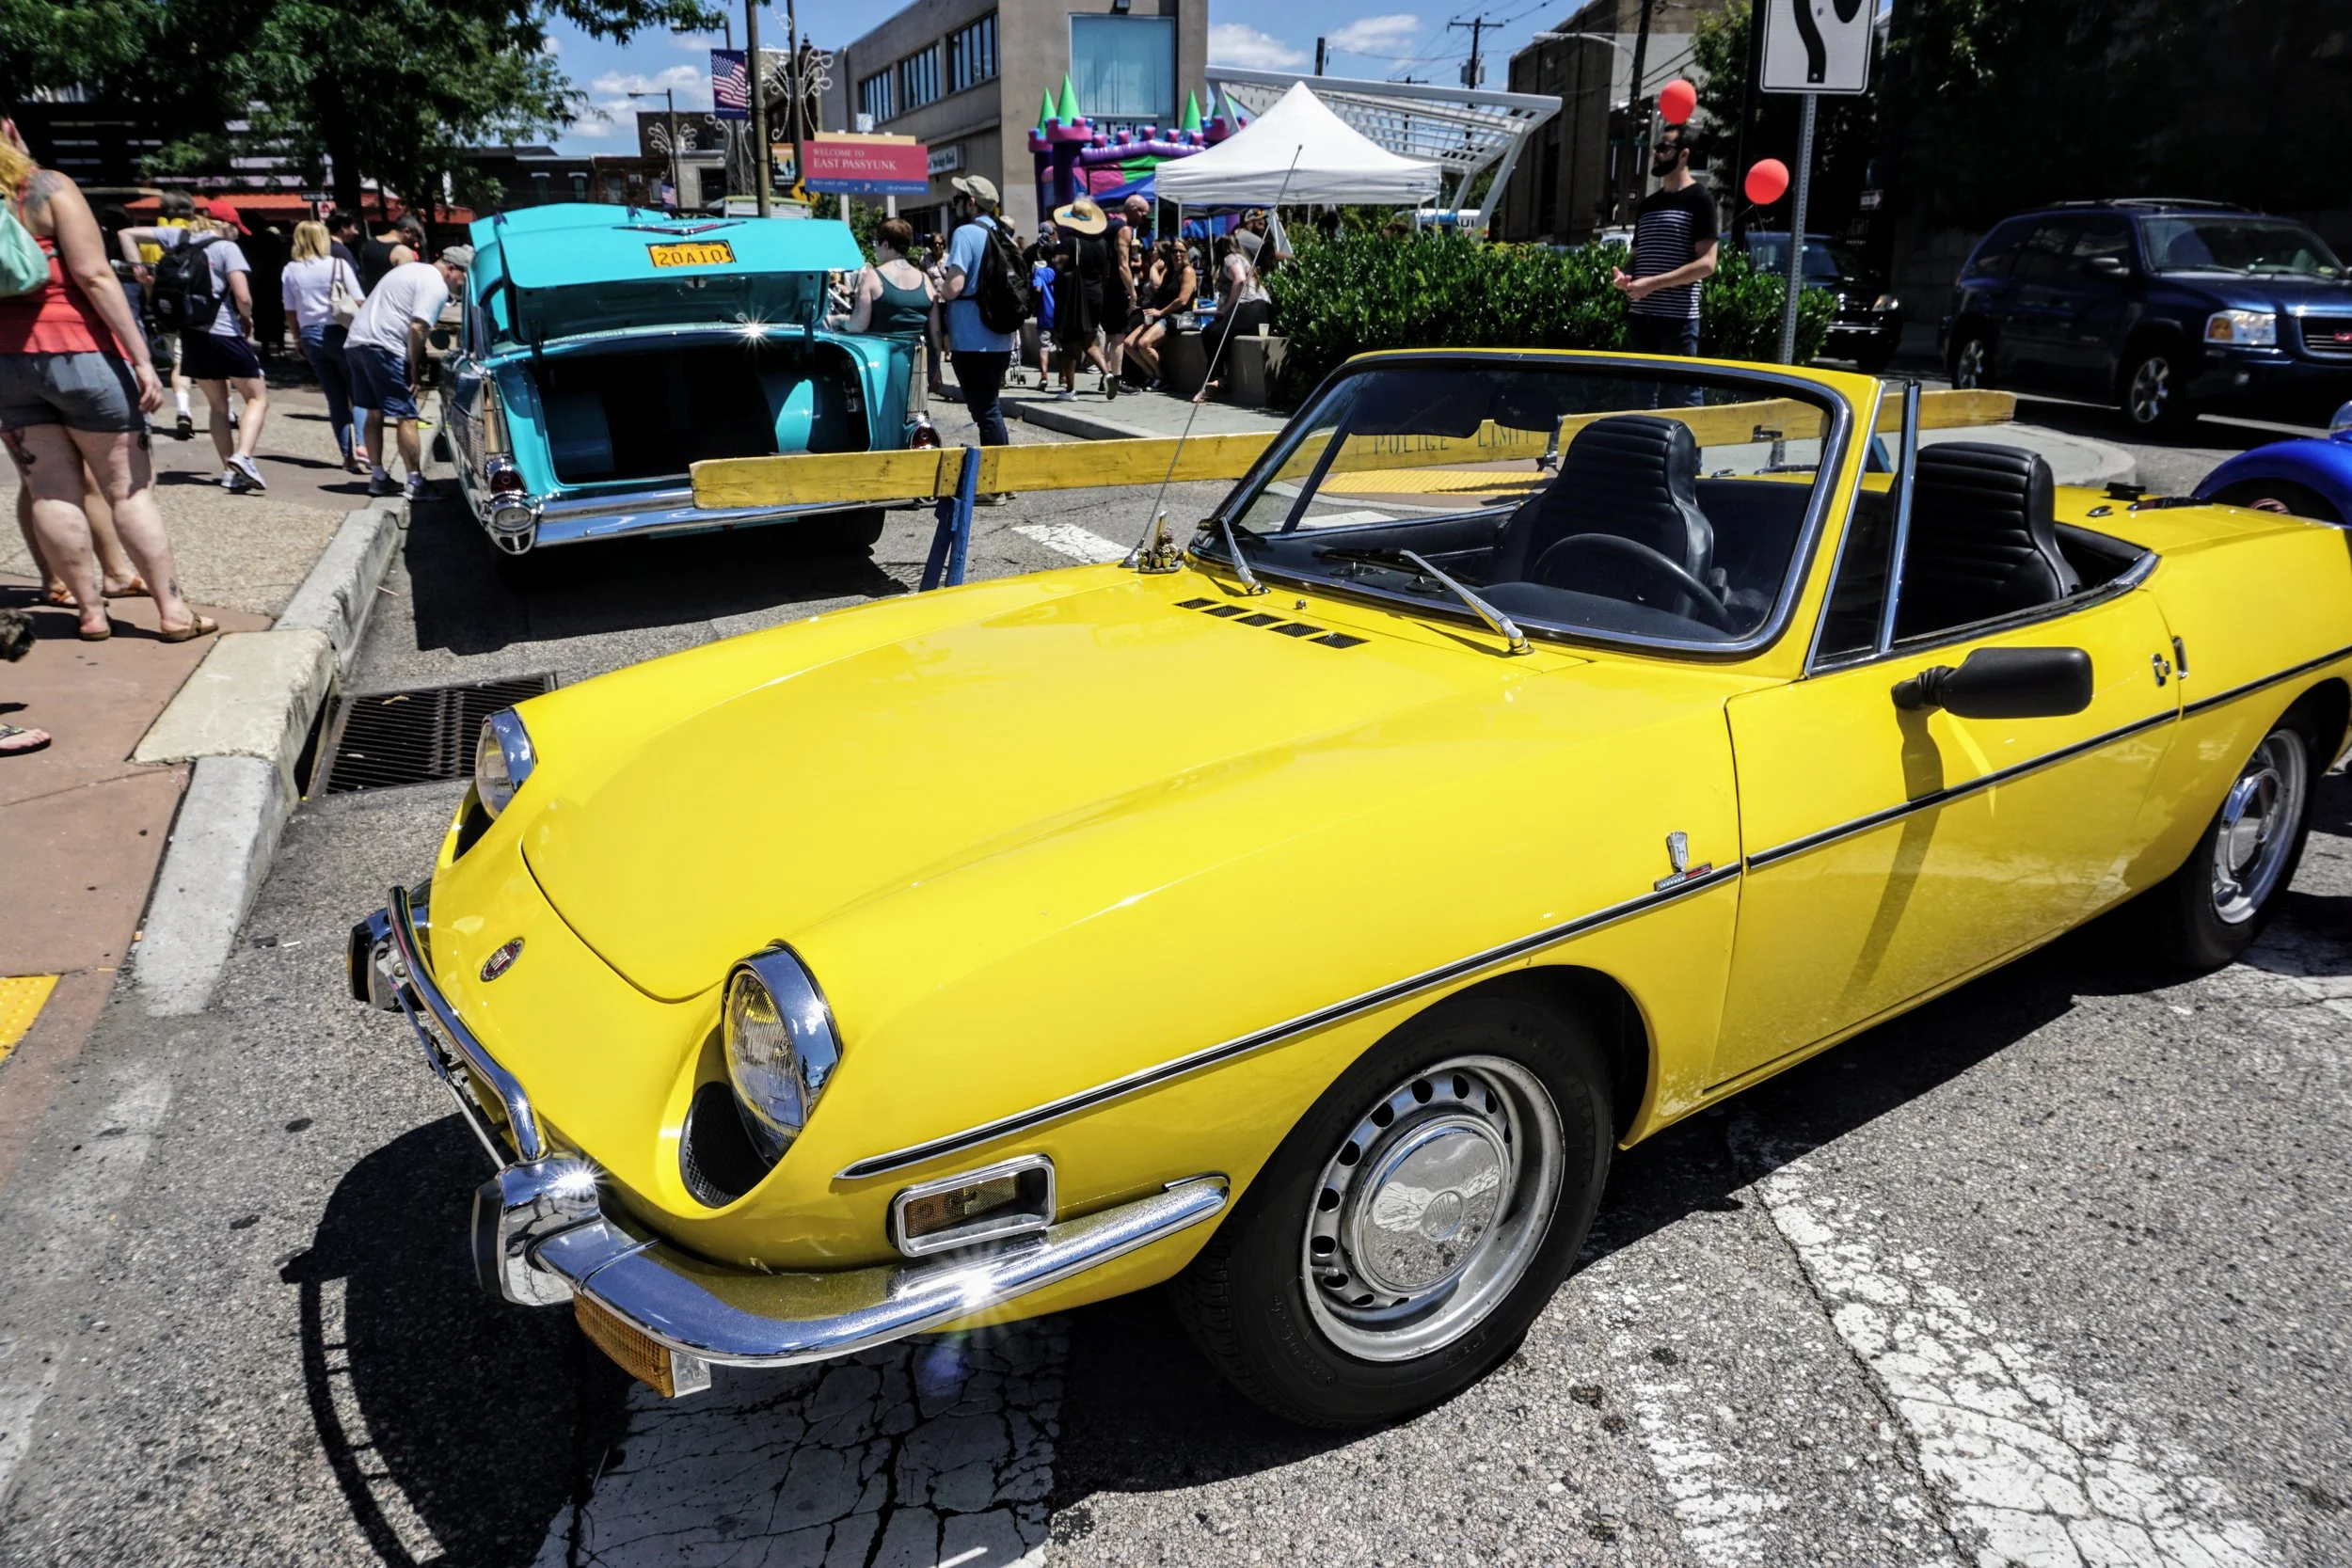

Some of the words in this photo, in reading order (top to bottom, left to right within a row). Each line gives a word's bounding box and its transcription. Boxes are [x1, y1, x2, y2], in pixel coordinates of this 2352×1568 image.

[813, 148, 851, 157] WELCOME
[813, 158, 839, 168] EAST
[842, 159, 897, 170] PASSYUNK
[1375, 435, 1449, 454] POLICE
